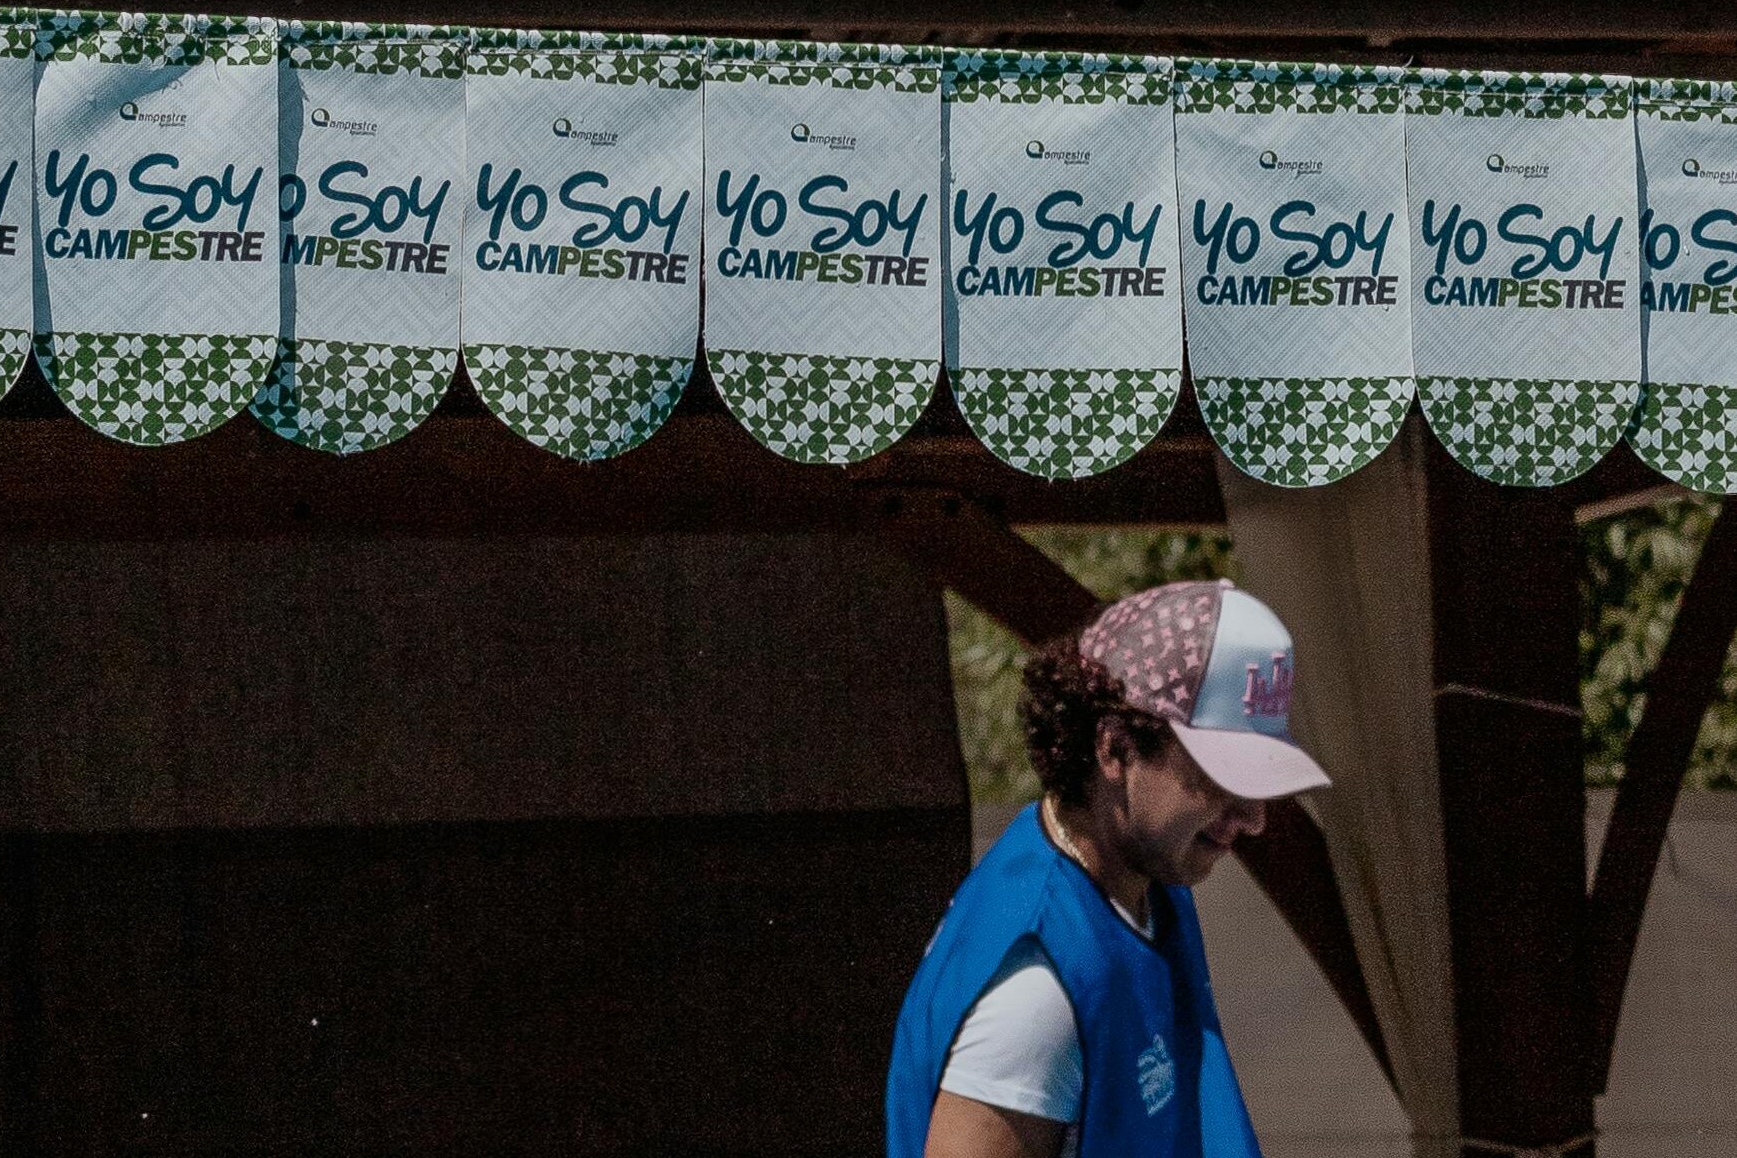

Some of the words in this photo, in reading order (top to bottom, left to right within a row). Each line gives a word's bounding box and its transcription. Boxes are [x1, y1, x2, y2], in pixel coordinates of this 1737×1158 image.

[45, 226, 265, 262] CAMPESTRE
[281, 233, 451, 274] MPESTRE
[475, 240, 689, 284] CAMPESTRE
[717, 246, 930, 286] CAMPESTRE
[956, 265, 1167, 297] CAMPESTRE
[1196, 274, 1399, 306] CAMPESTRE
[1424, 275, 1626, 309] CAMPESTRE
